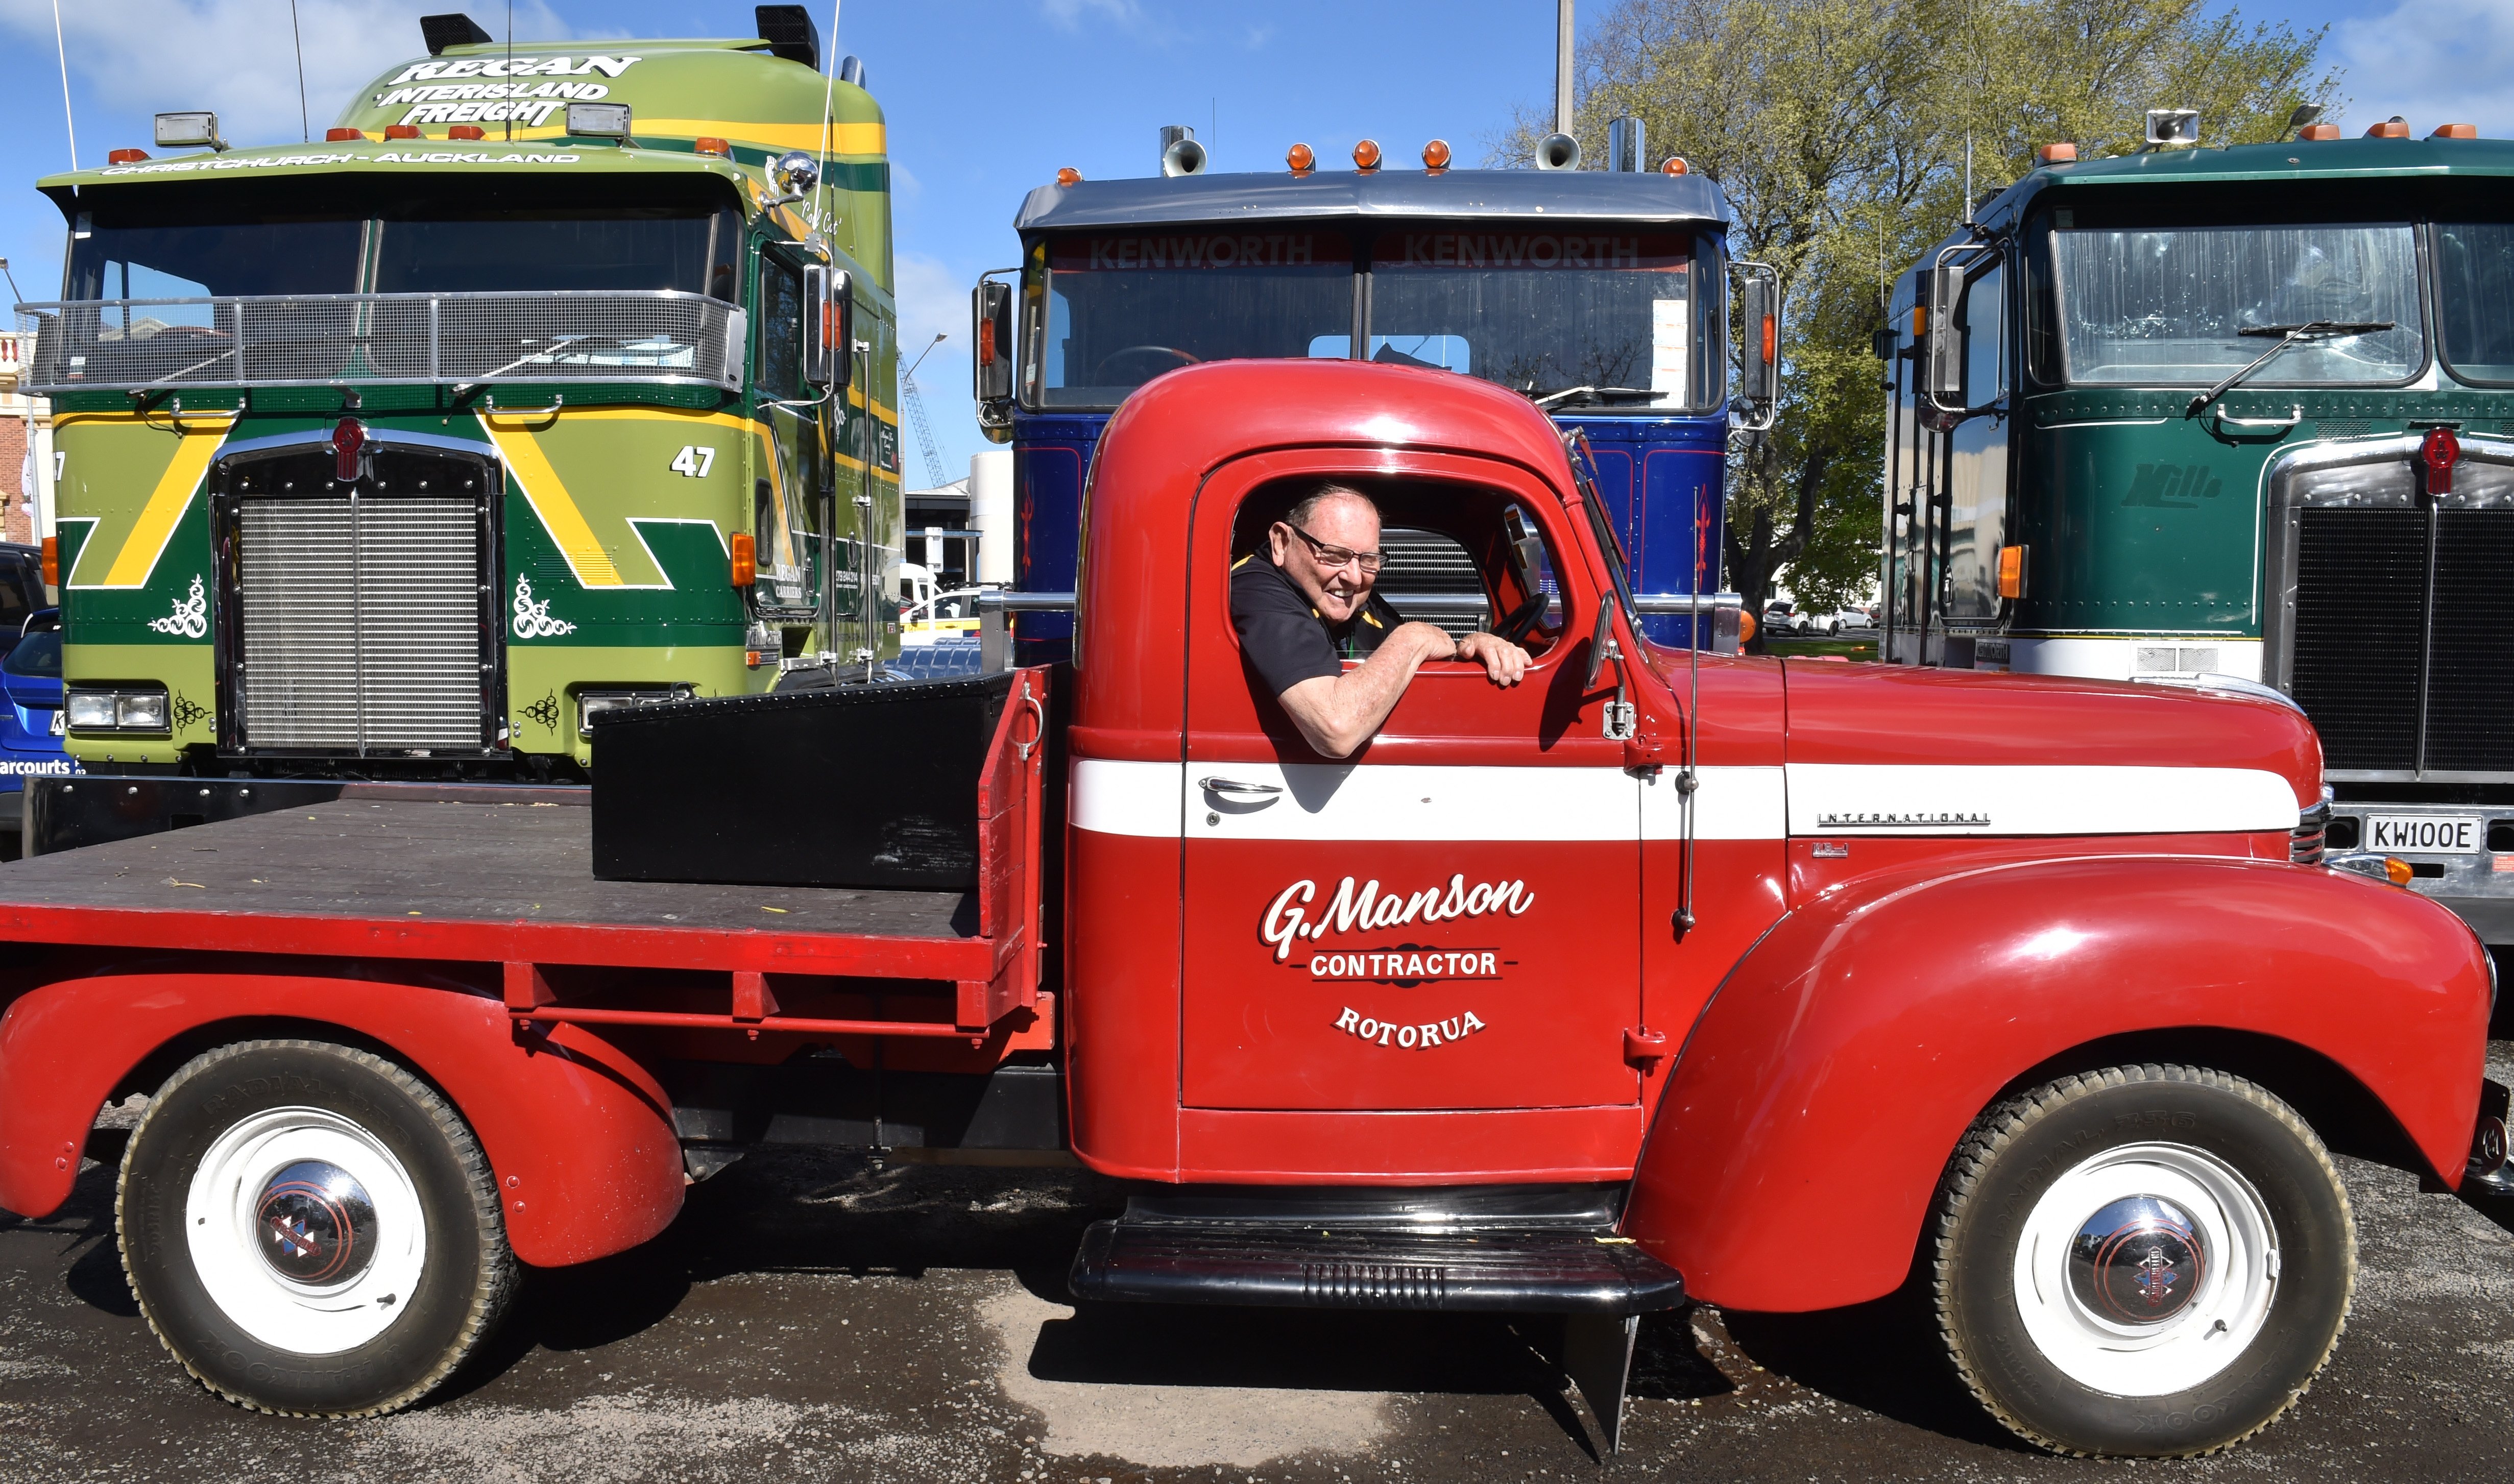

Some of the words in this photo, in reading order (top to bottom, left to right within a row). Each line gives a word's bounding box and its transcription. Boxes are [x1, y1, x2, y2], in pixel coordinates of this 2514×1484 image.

[384, 56, 642, 88] REGAN
[398, 101, 567, 127] FREIGHT
[102, 153, 353, 176] CHRISTCHURCH
[372, 153, 581, 163] AUCKLAND
[1090, 235, 1313, 269] KENWORTH
[1405, 234, 1638, 268] KENWORTH
[669, 445, 715, 478] 47
[776, 564, 801, 582] REGAN
[776, 586, 802, 599] CARRIERS
[1817, 813, 1991, 824] INTERNATIONAL
[2375, 821, 2472, 848] KW100E
[1310, 953, 1496, 976] CONTRACTOR
[1333, 1006, 1486, 1049] ROTORUA
[201, 1076, 333, 1116] RADIAL
[197, 1328, 377, 1389] HANKOOK
[2132, 1325, 2306, 1434] HANKOOK
